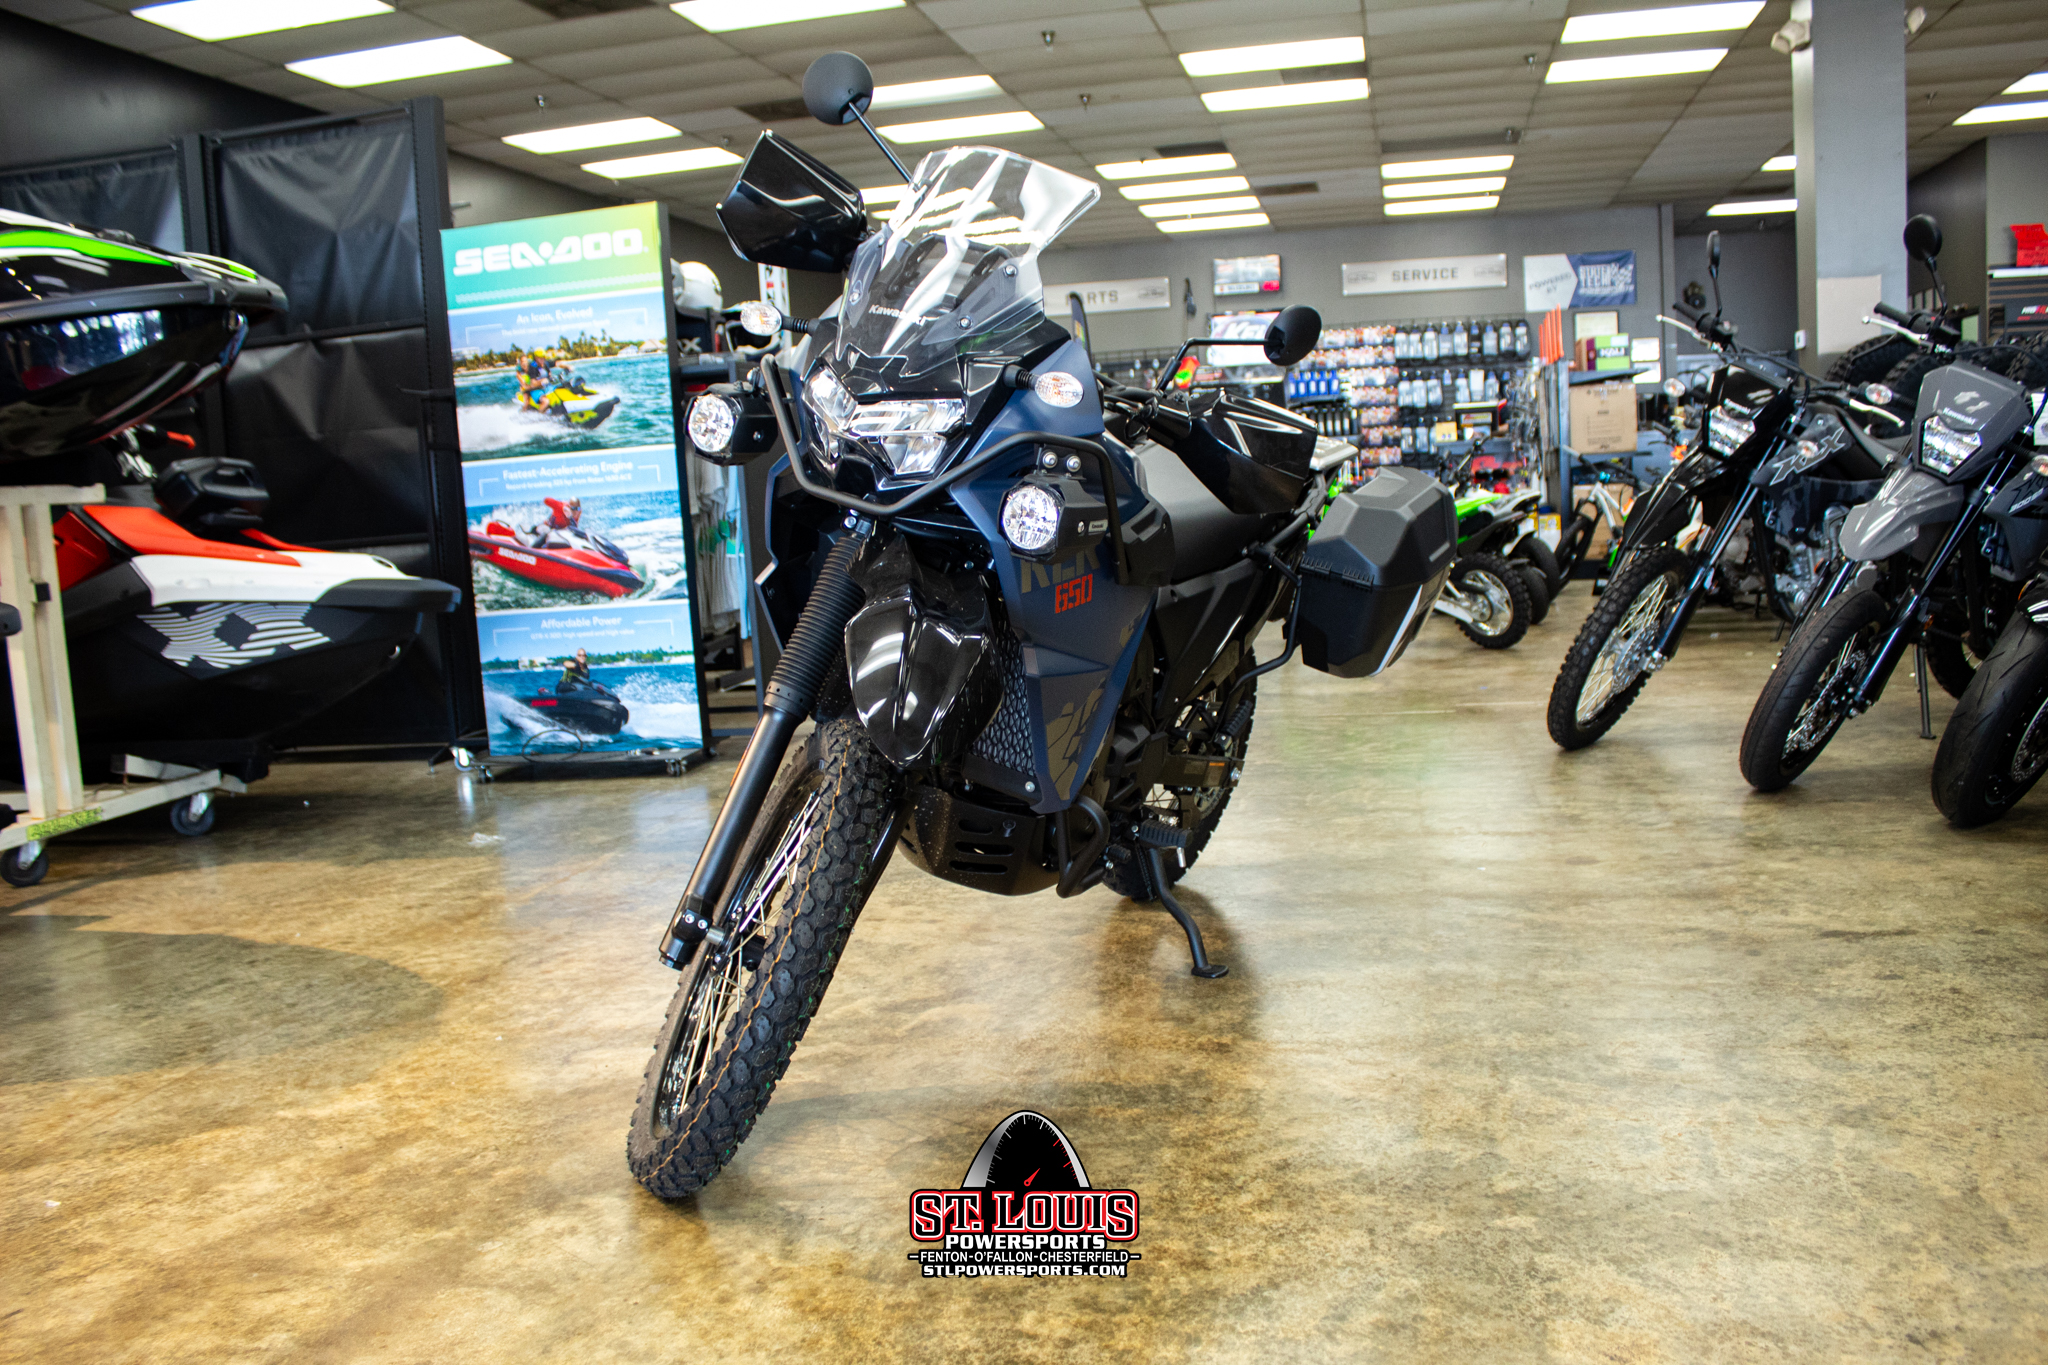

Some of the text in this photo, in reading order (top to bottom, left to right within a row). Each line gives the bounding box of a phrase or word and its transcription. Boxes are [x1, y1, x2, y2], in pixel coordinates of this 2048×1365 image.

[1391, 267, 1459, 282] SERVICE
[1065, 290, 1119, 307] RTS
[516, 313, 530, 325] An
[555, 306, 594, 321] Evolved
[1942, 406, 1977, 425] Kawasaki
[502, 460, 634, 480] Fastest-Accelerating Engine
[1055, 573, 1093, 614] 650
[540, 616, 622, 629] Affordable Power
